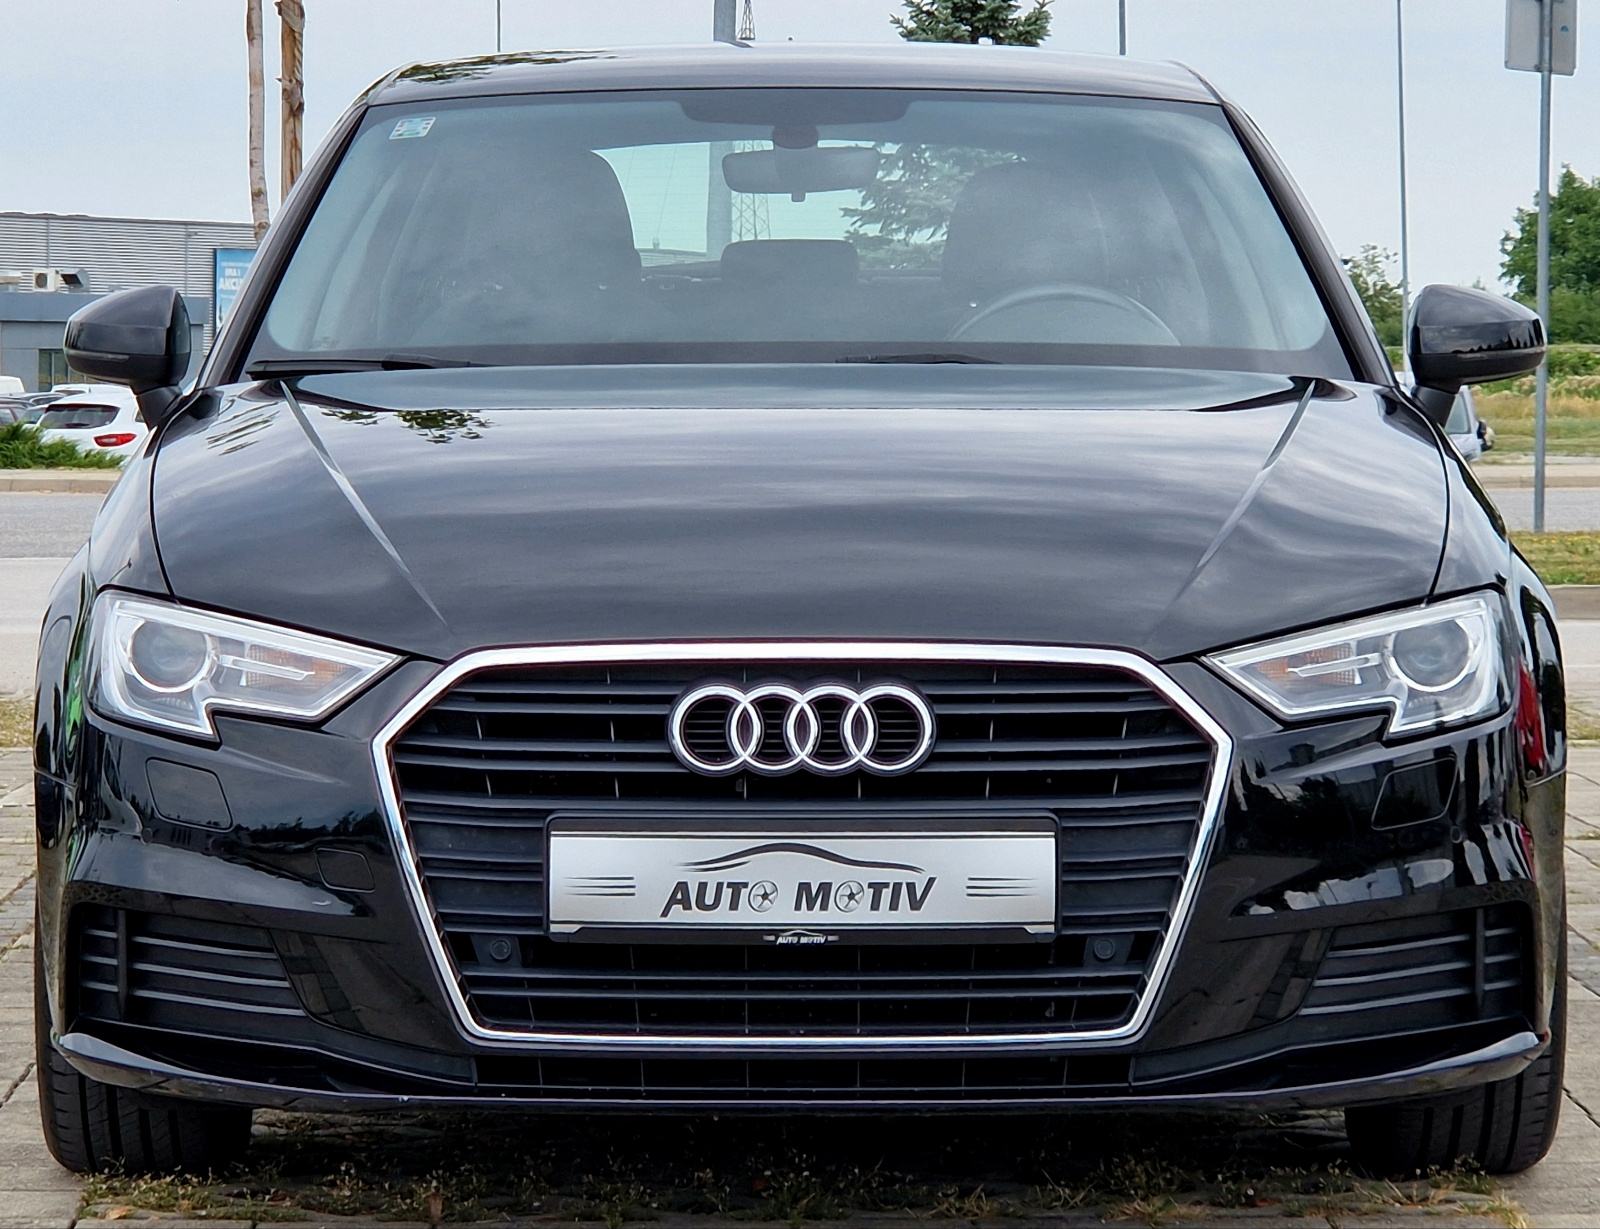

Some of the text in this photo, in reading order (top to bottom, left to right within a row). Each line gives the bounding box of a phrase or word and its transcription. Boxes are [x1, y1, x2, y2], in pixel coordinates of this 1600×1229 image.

[660, 877, 937, 917] AUTO MOTIV
[776, 936, 826, 945] AUTO MOTIV
